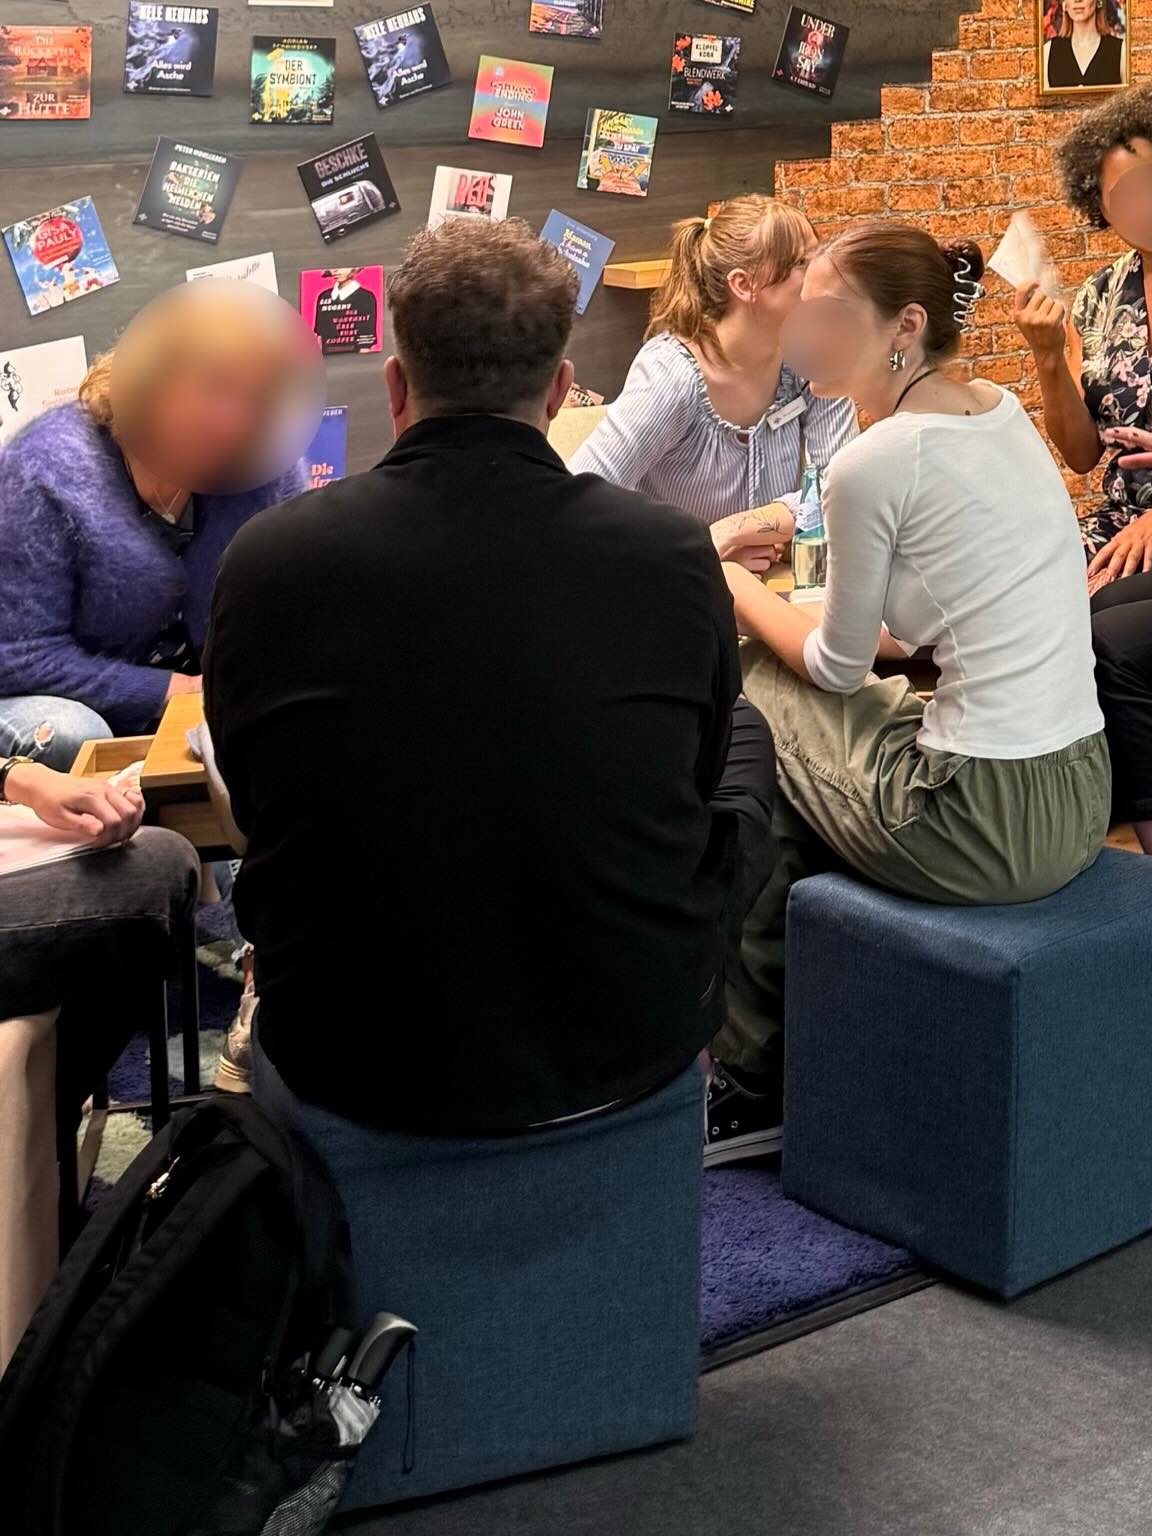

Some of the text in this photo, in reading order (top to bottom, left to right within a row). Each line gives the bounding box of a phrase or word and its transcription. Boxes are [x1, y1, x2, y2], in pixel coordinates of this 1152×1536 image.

[139, 5, 209, 24] NELE NEUHAUS
[363, 7, 427, 41] NELE NEUHAUS
[801, 13, 836, 38] UNDER
[153, 60, 192, 71] Alles wird
[285, 59, 303, 72] DER
[157, 70, 185, 80] Asche
[270, 73, 317, 85] SYMBIONT
[401, 72, 425, 86] Asche
[683, 66, 727, 81] BLENDWERK
[33, 93, 56, 105] ZUR
[495, 88, 533, 103] ENDING
[18, 102, 71, 116] HÜTTE
[496, 107, 525, 121] JOHN
[492, 118, 525, 131] GREEN
[174, 144, 194, 155] PETER
[314, 143, 368, 179] GESCHKE
[170, 161, 221, 183] BAKTERIEN
[38, 222, 71, 239] GISA
[37, 228, 78, 251] PAULY
[311, 462, 334, 476] Die
